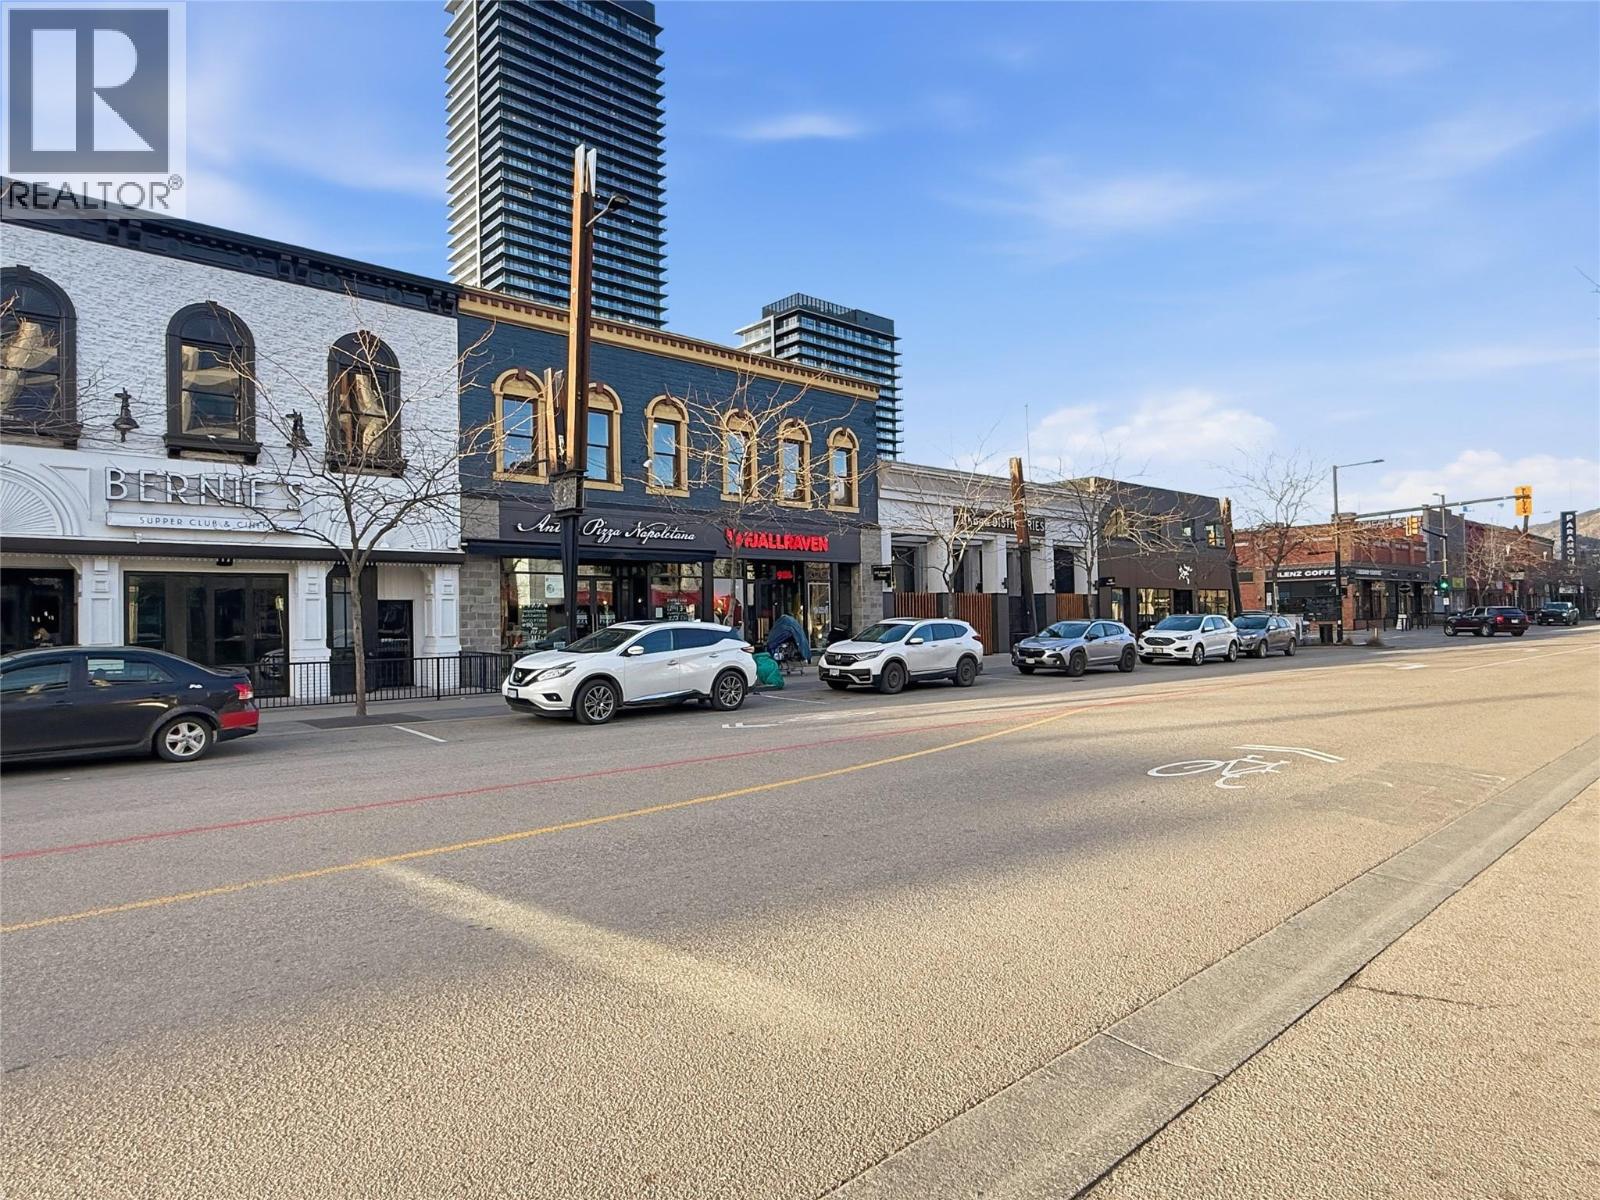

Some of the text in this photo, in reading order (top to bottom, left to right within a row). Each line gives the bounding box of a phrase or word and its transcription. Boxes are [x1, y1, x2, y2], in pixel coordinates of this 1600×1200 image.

[105, 467, 304, 512] BERNIES
[139, 516, 277, 530] SUPPER CLUB & CINEM
[517, 514, 696, 545] Ant Pizza Napoletana
[992, 517, 1045, 532] DISTIRIES
[1304, 569, 1338, 577] COFFE
